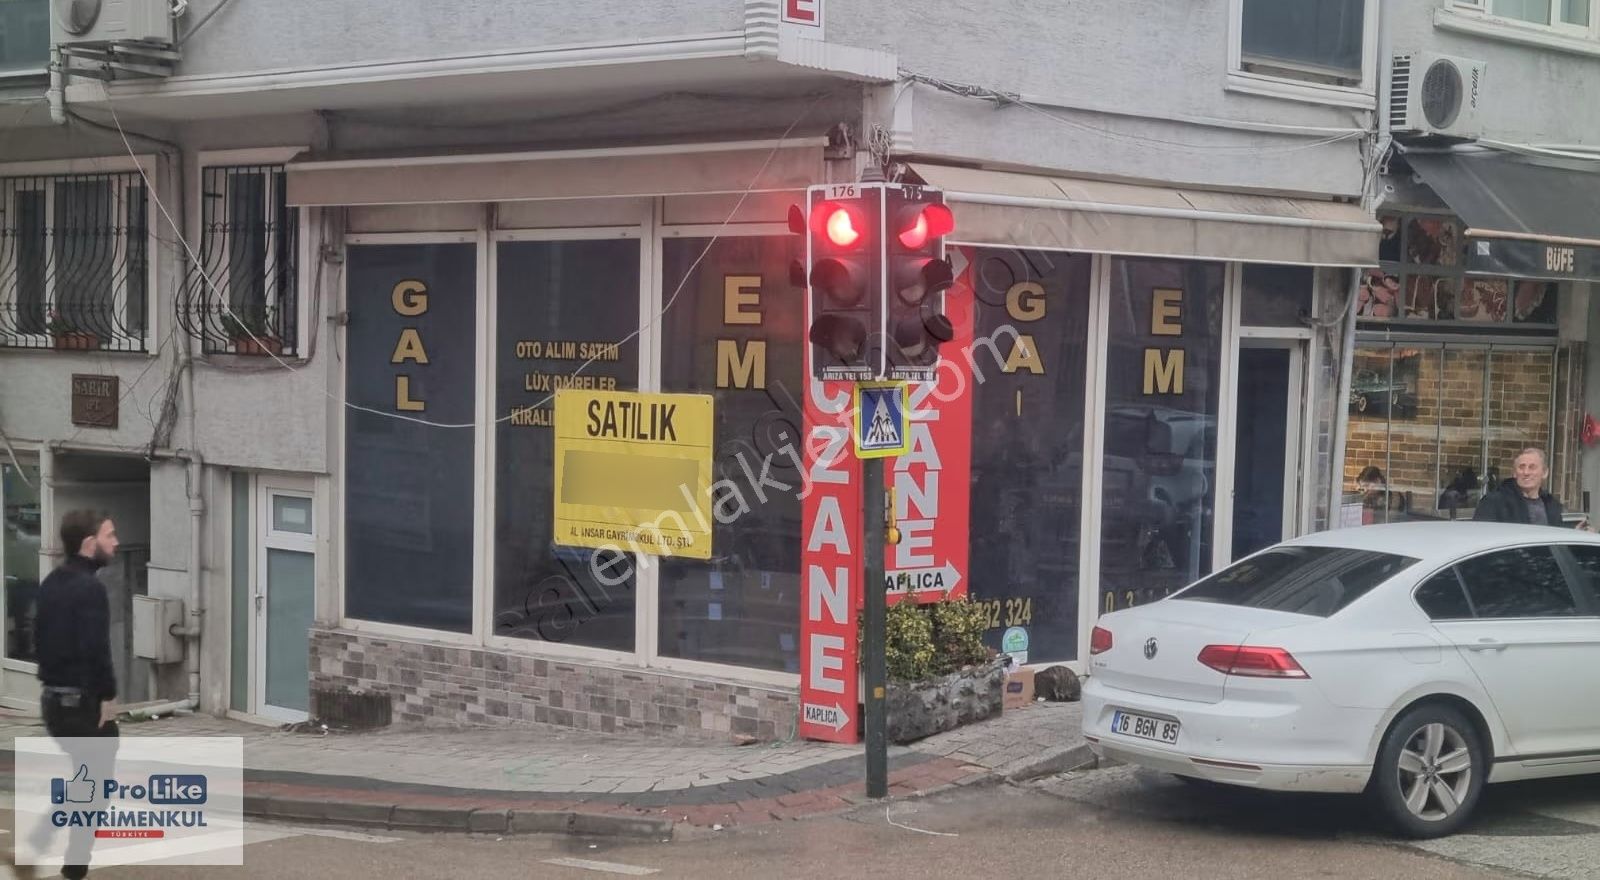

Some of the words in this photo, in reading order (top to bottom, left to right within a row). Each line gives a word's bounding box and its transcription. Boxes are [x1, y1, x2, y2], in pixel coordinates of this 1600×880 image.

[832, 185, 855, 197] 176
[1546, 246, 1574, 272] BÜFE
[391, 280, 429, 411] GAL
[516, 341, 541, 358] OTO
[545, 342, 576, 359] ALIM
[580, 342, 619, 360] SATIM
[525, 370, 550, 391] LÜX
[845, 372, 857, 381] TEL
[511, 405, 553, 426] KİRALI
[587, 400, 677, 441] SATILIK
[885, 572, 944, 591] APLICA
[1005, 598, 1031, 628] 324
[806, 705, 838, 724] KAPLICA
[1118, 713, 1129, 732] 16
[1135, 716, 1158, 738] BGN
[1162, 722, 1178, 741] 85
